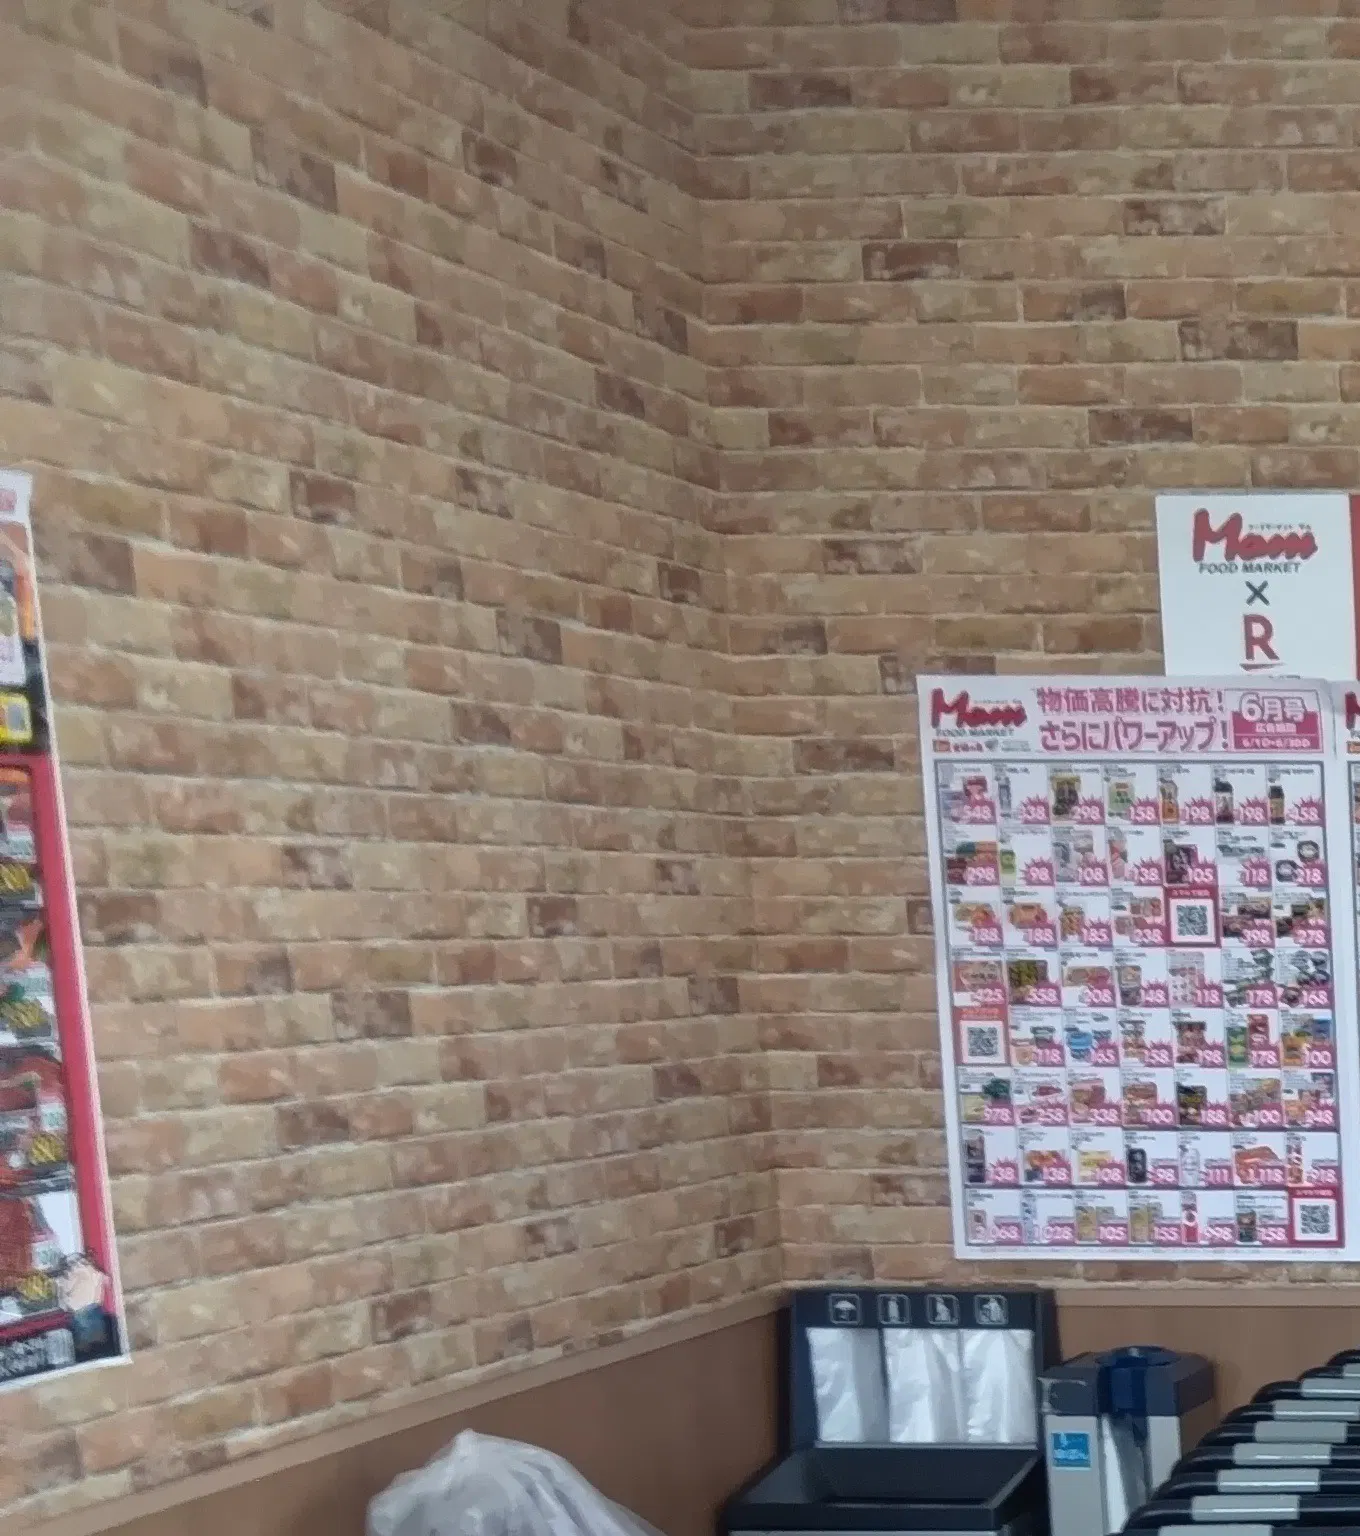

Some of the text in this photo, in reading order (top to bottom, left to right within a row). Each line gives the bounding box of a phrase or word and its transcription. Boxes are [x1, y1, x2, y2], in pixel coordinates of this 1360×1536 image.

[1199, 563, 1301, 574] FOOD MARKET
[1244, 614, 1280, 660] R
[1184, 806, 1210, 821] 198
